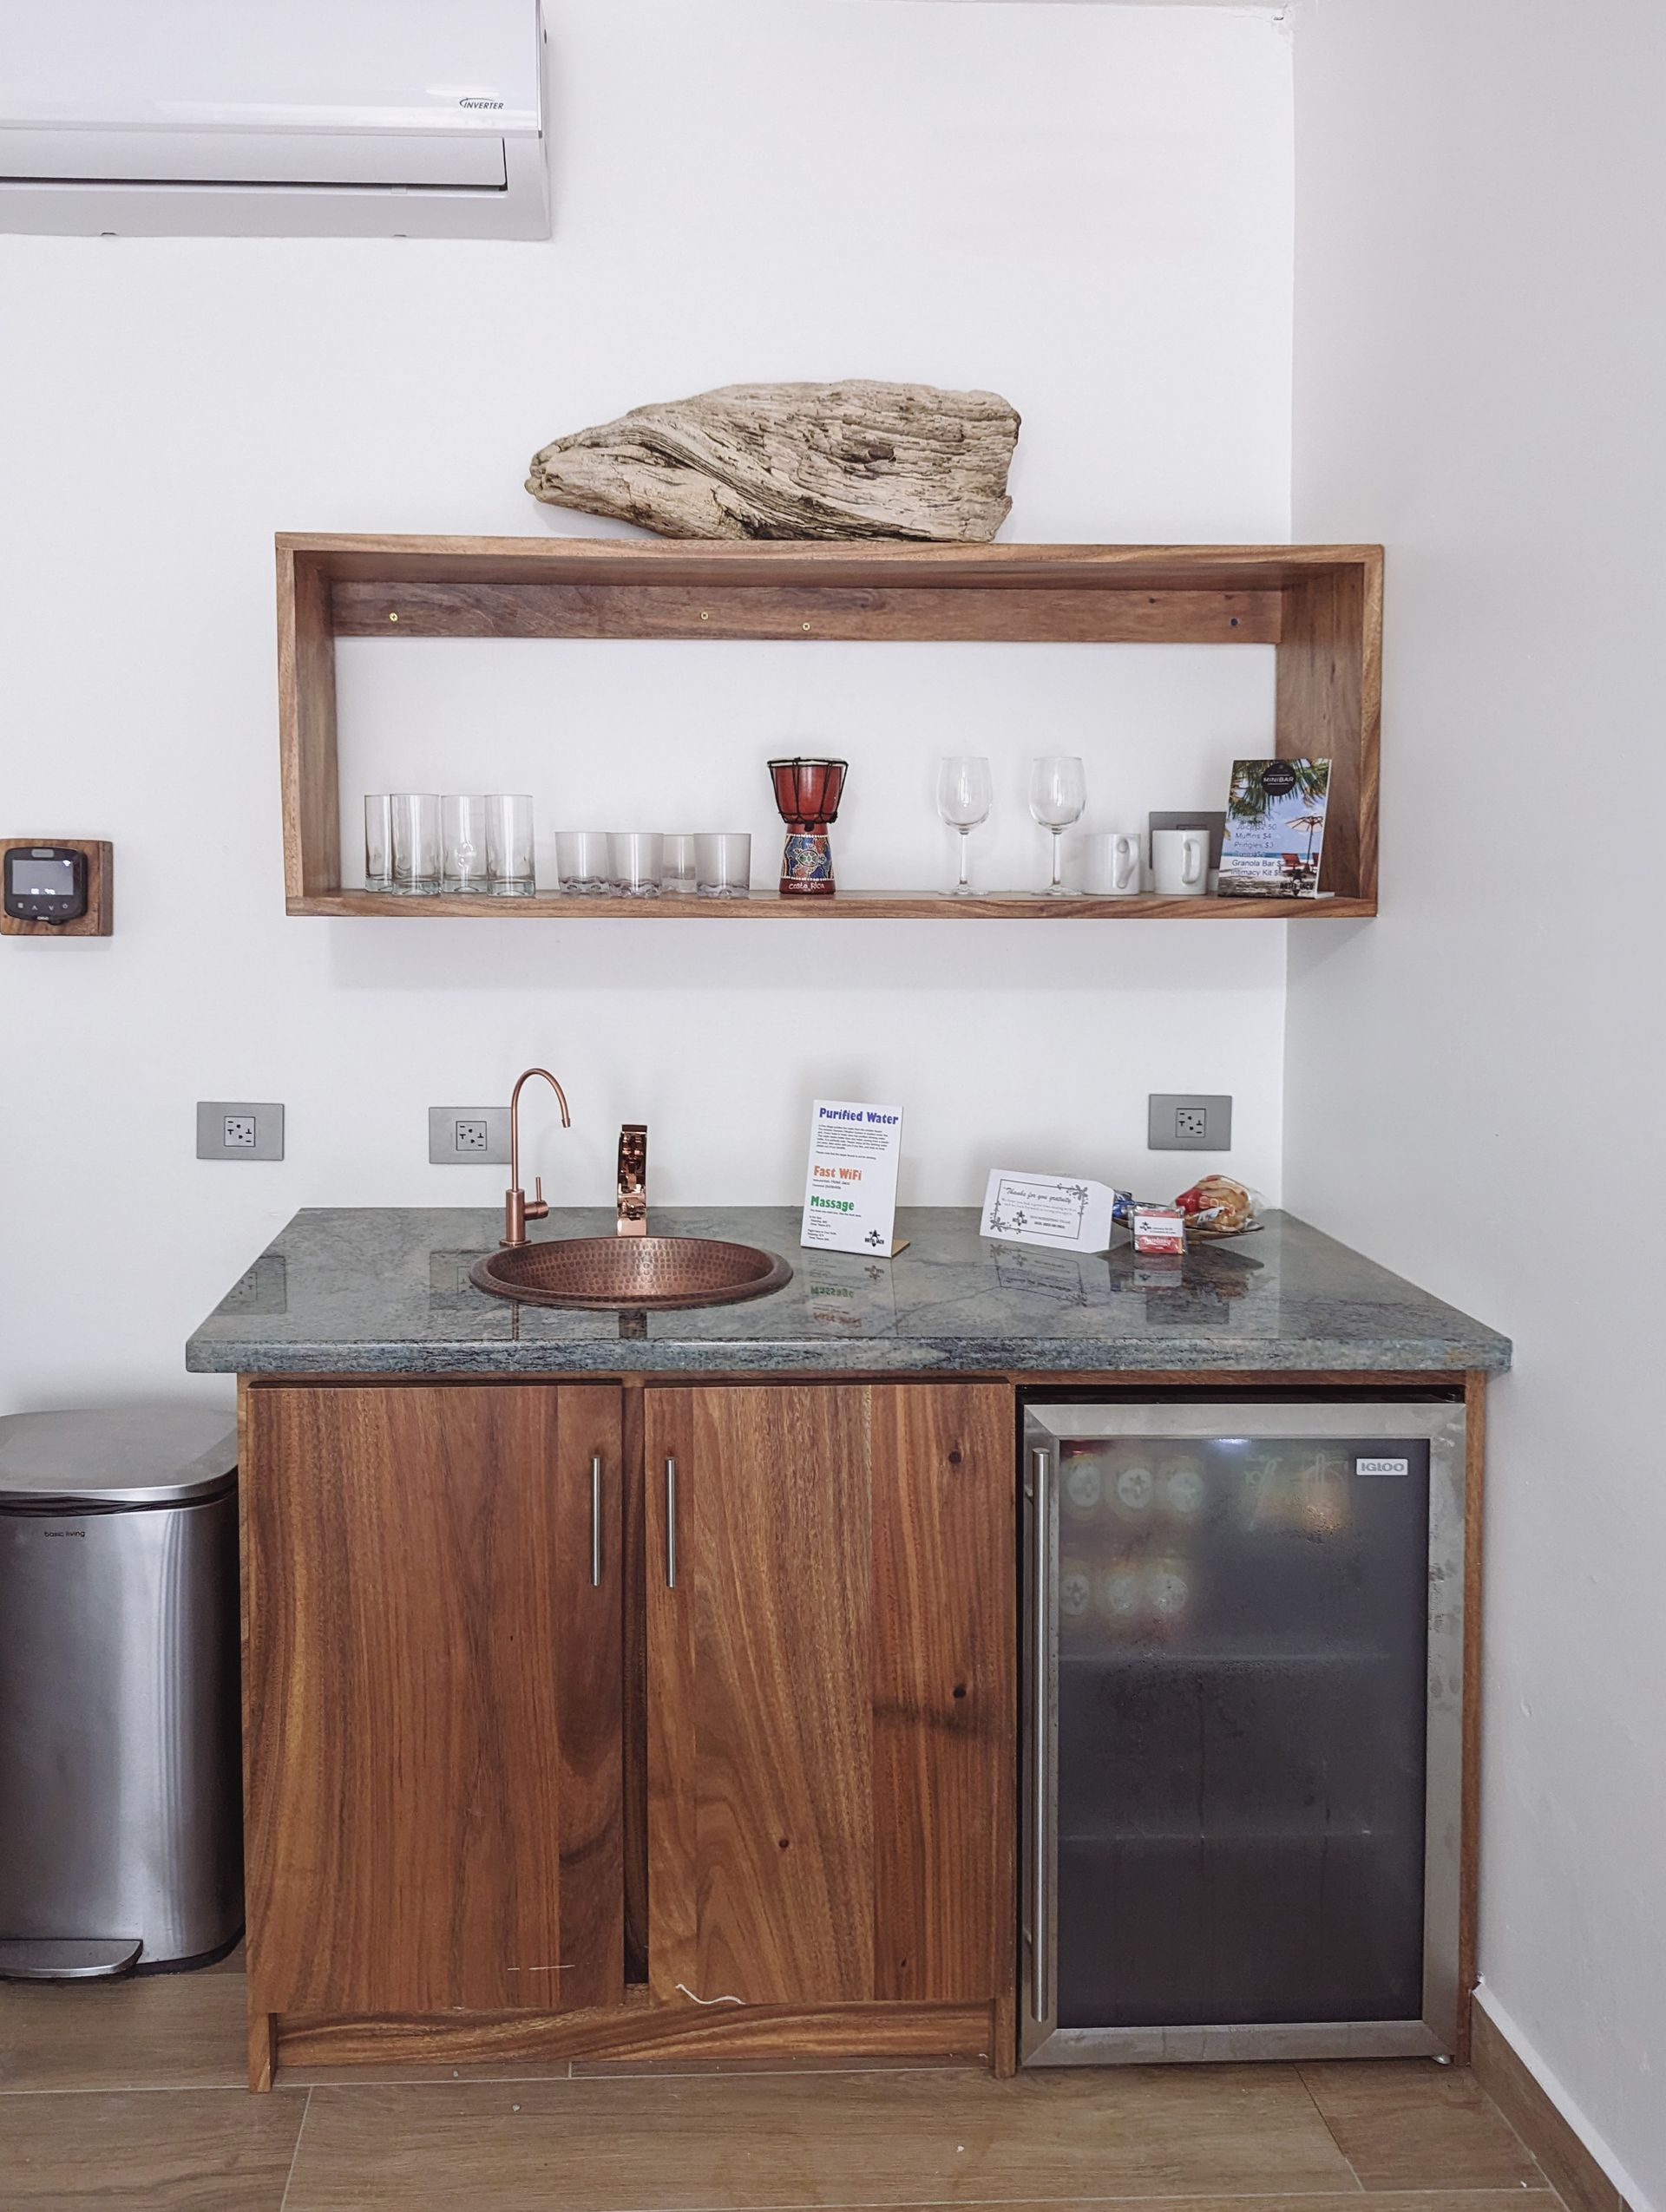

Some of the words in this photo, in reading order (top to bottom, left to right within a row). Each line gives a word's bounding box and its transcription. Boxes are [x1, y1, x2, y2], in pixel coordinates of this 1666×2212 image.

[819, 1107, 863, 1122] Purified
[866, 1111, 899, 1125] Water
[813, 1165, 836, 1178] Fast
[839, 1168, 863, 1181] WiFi
[810, 1195, 855, 1212] Massage
[1361, 1463, 1405, 1472] IGLOO
